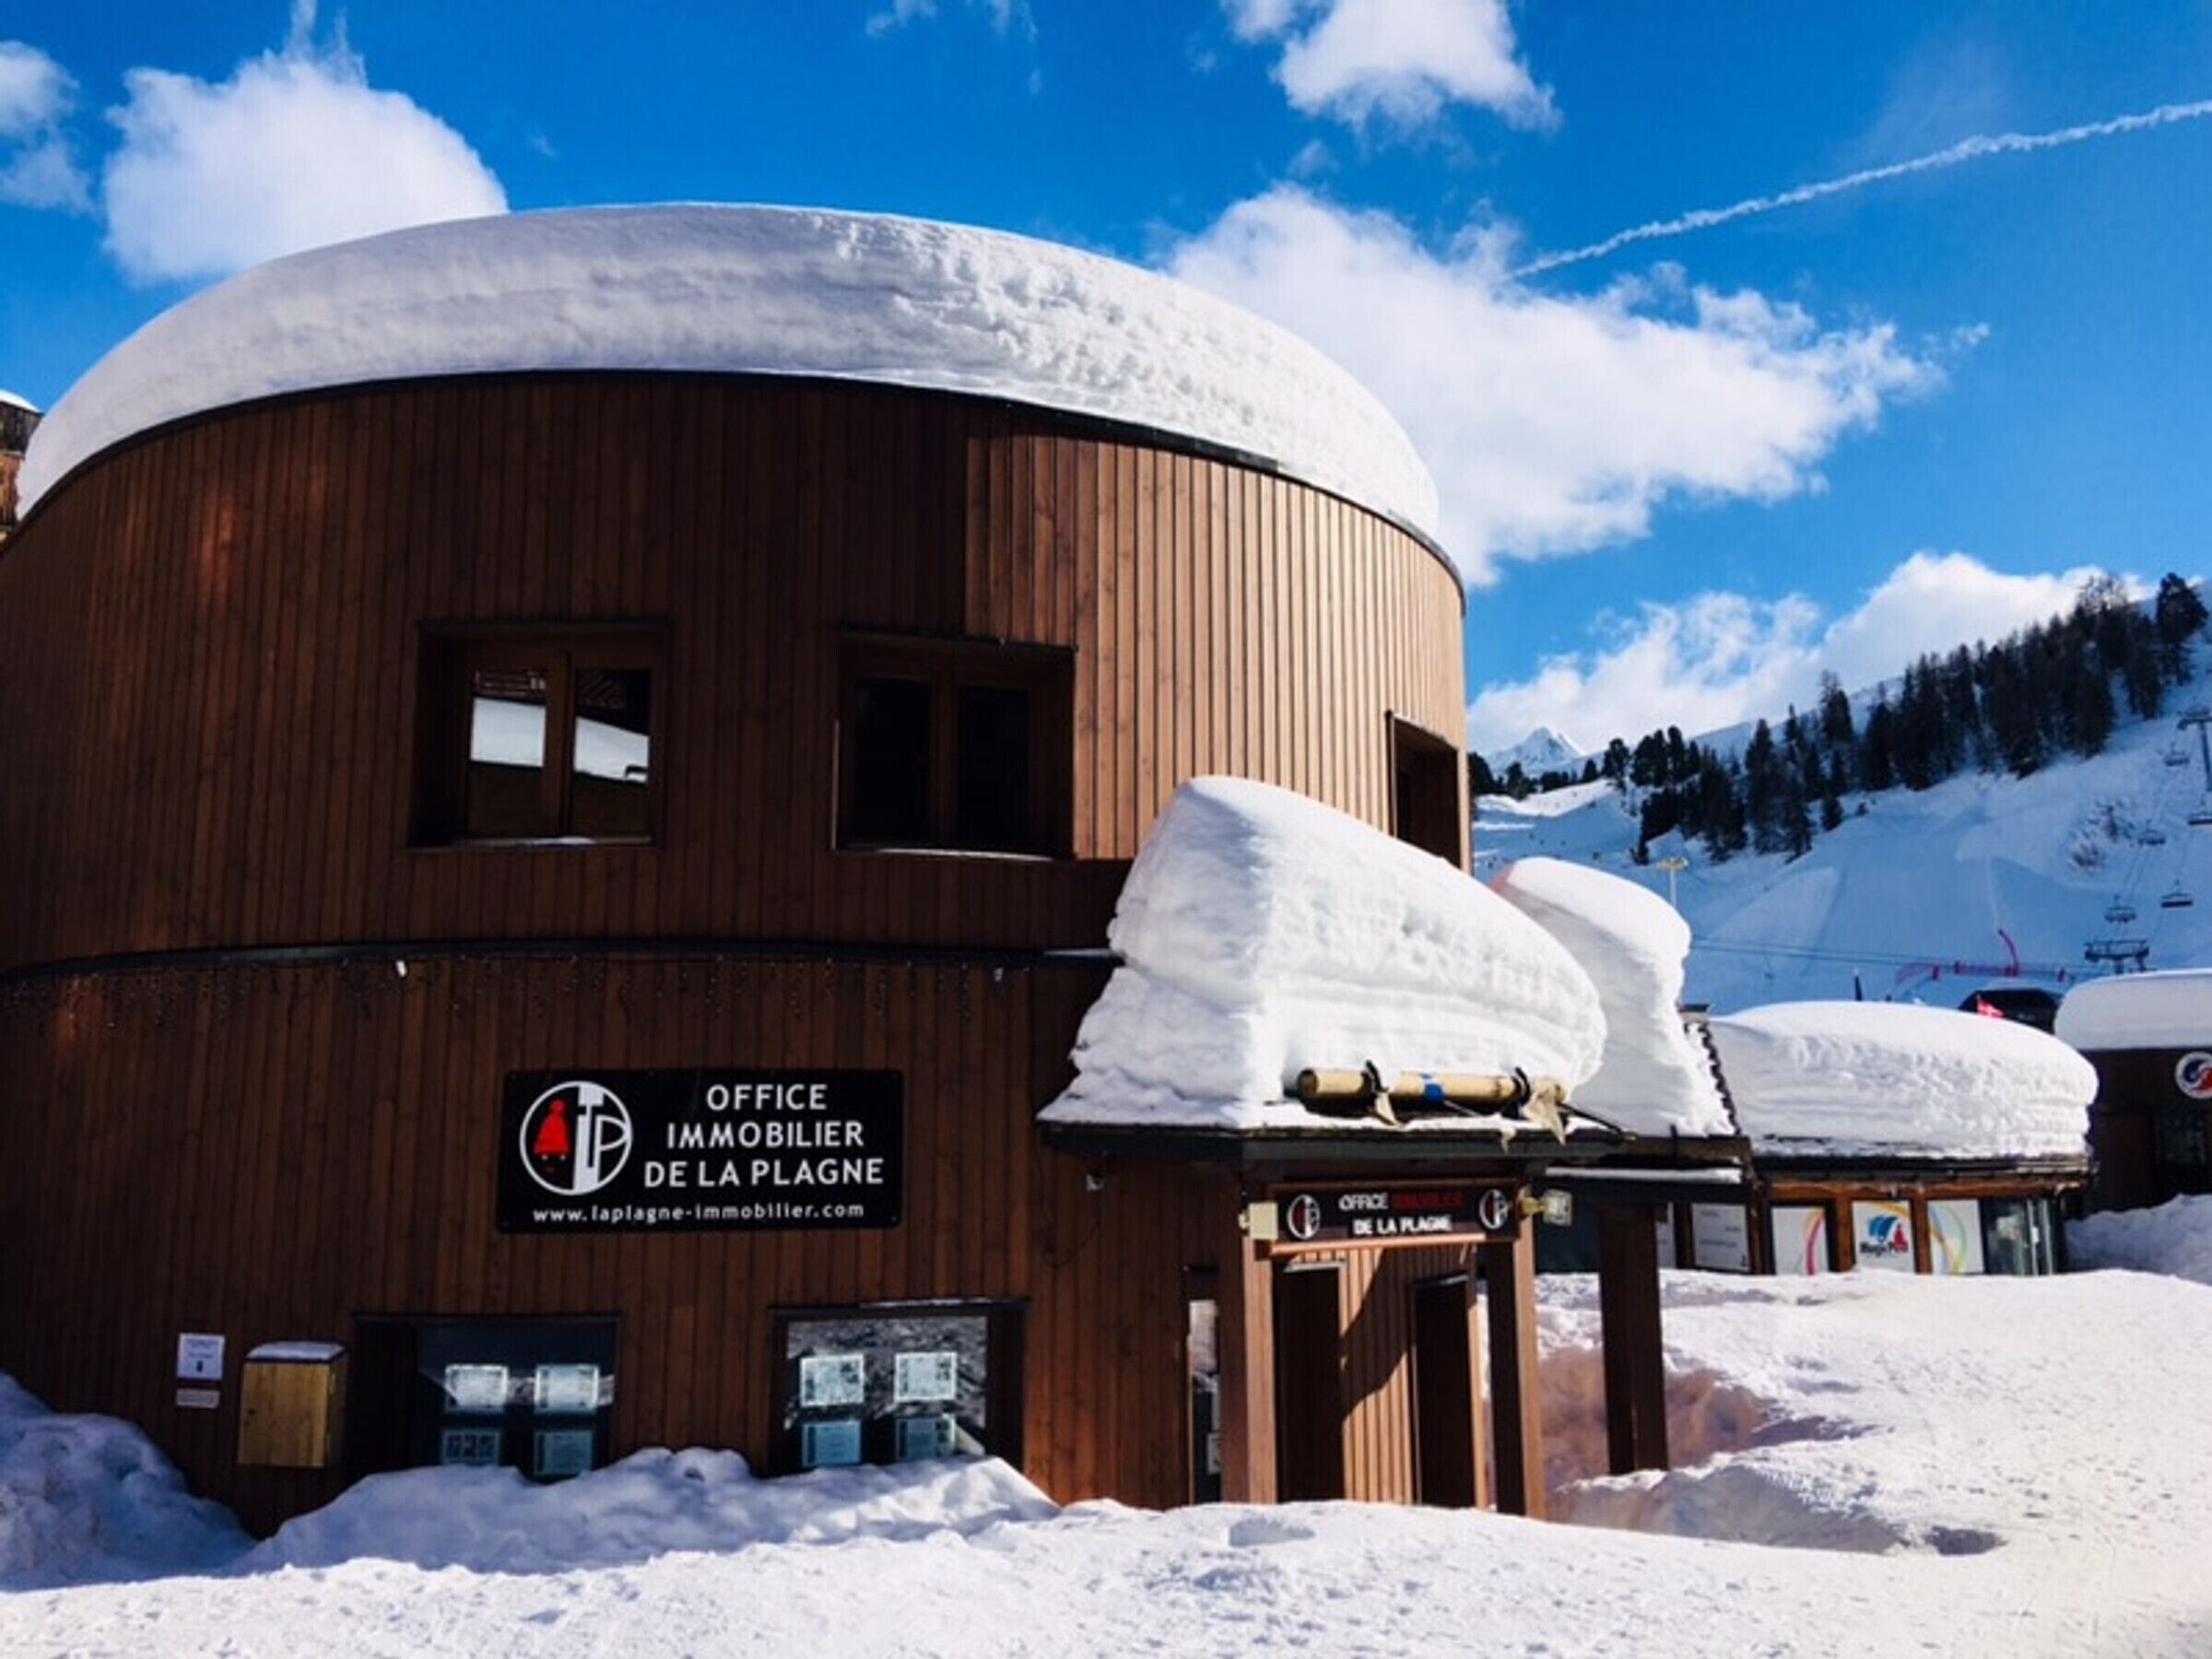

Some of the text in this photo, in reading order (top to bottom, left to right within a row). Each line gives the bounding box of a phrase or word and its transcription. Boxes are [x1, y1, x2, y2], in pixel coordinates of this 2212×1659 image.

[706, 1083, 828, 1111] OFFICE
[666, 1120, 865, 1149] IMMOBILIER
[644, 1158, 884, 1188] DE LA PLAGNE
[533, 1203, 865, 1225] www.laplagne-immobilier.com
[1337, 1192, 1389, 1212] OFFICE
[1352, 1214, 1453, 1236] DE LA PLAGNE
